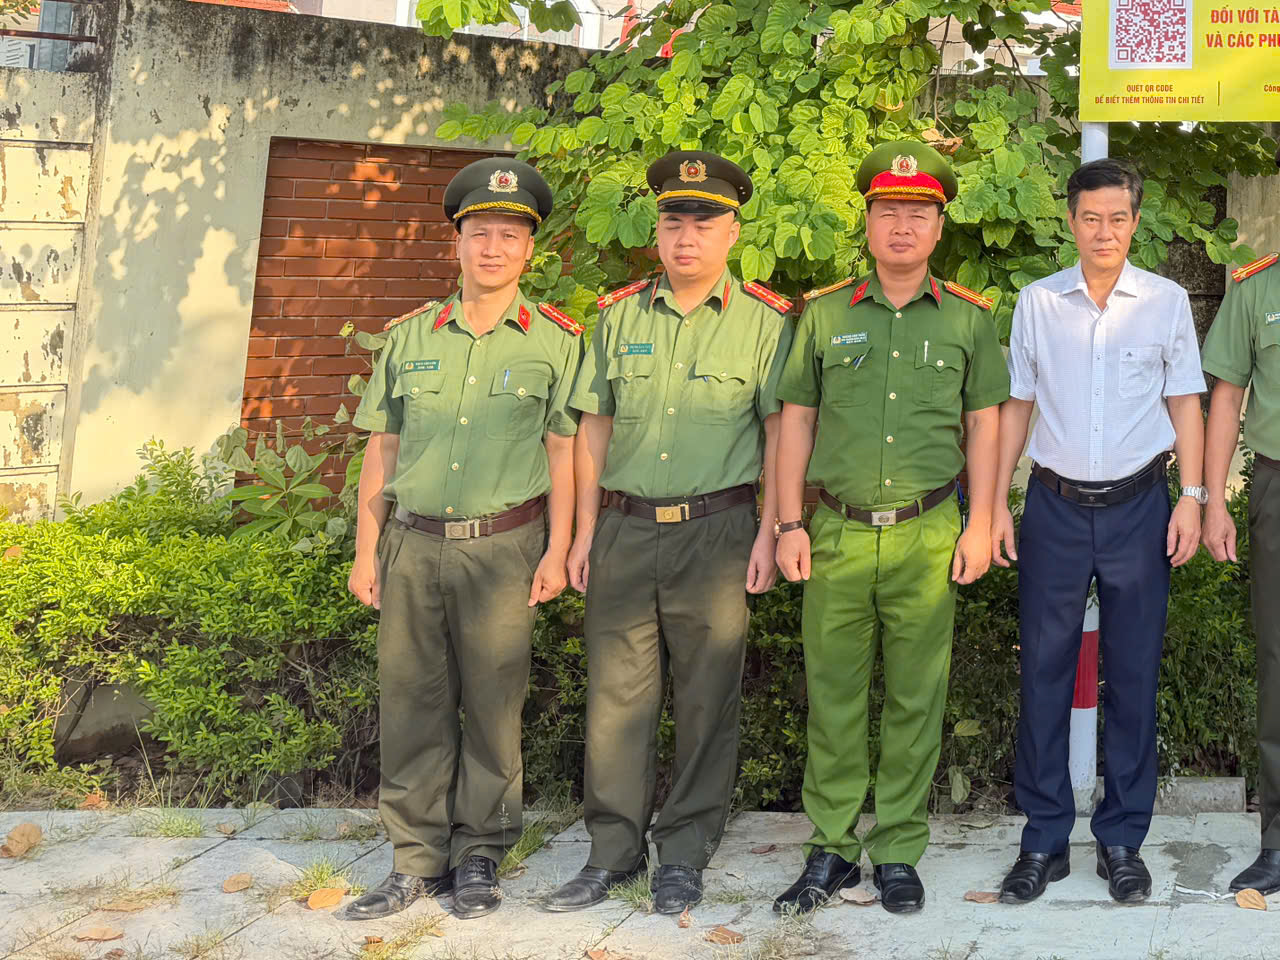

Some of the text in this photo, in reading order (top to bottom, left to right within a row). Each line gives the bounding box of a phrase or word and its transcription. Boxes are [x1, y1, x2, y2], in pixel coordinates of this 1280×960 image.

[1210, 4, 1233, 24] ĐỐI
[1237, 6, 1259, 24] VỚI
[1206, 30, 1223, 48] VÀ
[1227, 30, 1254, 48] CÁC
[1145, 84, 1154, 93] QR
[1156, 84, 1173, 92] CODE
[1166, 96, 1176, 104] TIN
[1178, 96, 1189, 104] CHI
